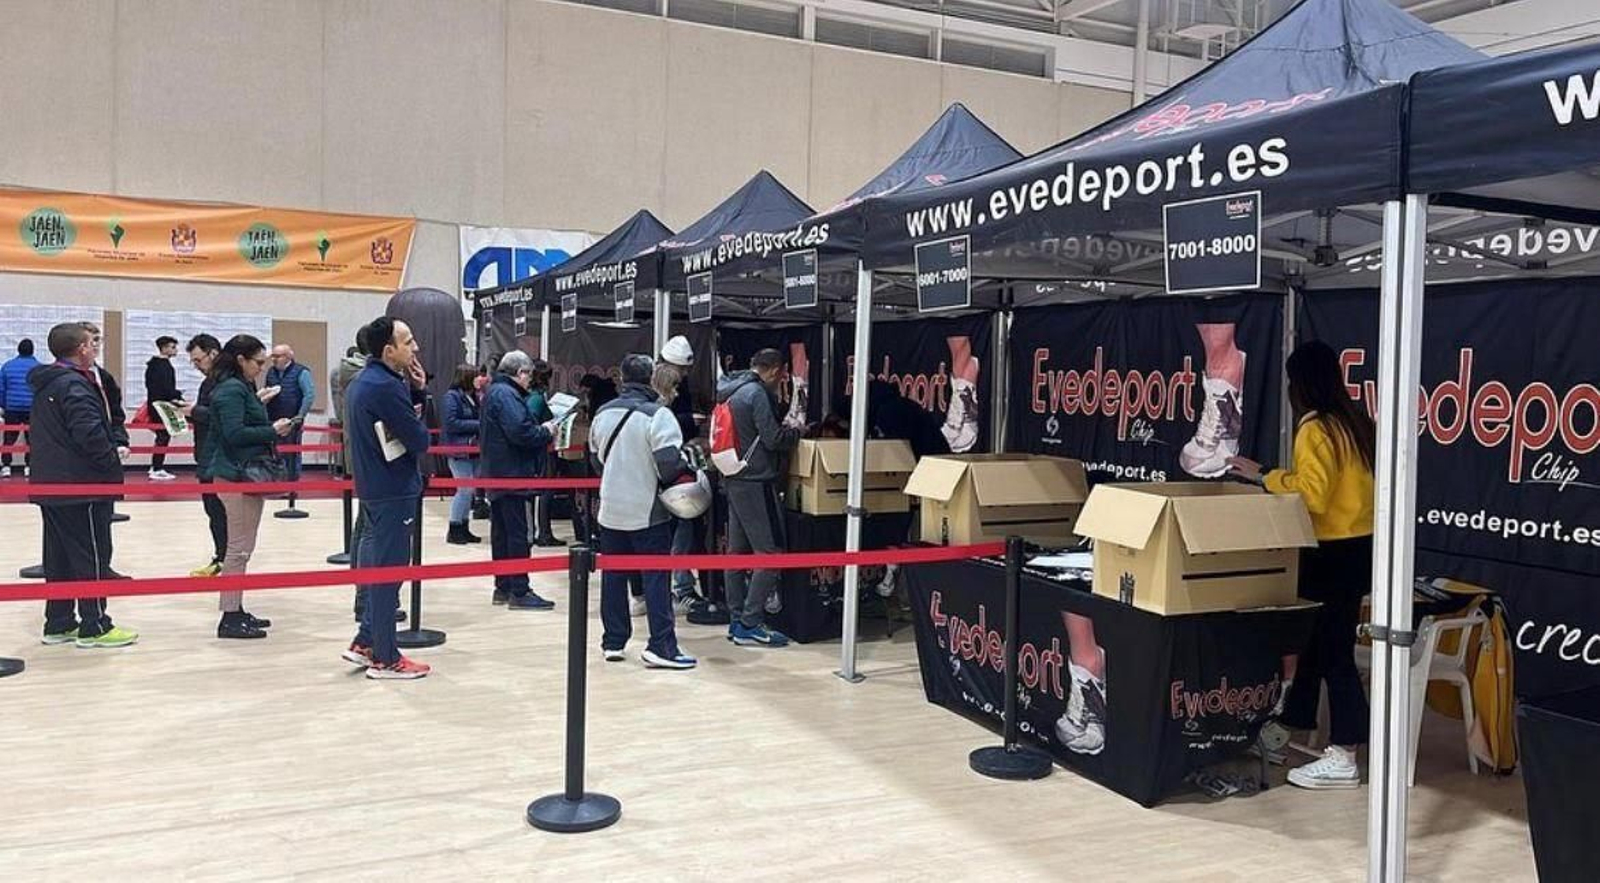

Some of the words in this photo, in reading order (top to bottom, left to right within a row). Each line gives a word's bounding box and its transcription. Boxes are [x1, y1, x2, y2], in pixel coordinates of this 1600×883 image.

[905, 137, 1290, 238] www.evedeport.es
[681, 223, 830, 274] www.evedeport.es
[1168, 234, 1256, 260] 7001-8000
[555, 260, 638, 292] www.evedeport.es
[1031, 346, 1197, 441] Evedeport
[1530, 452, 1580, 492] Chip
[930, 590, 1065, 700] Evedeort
